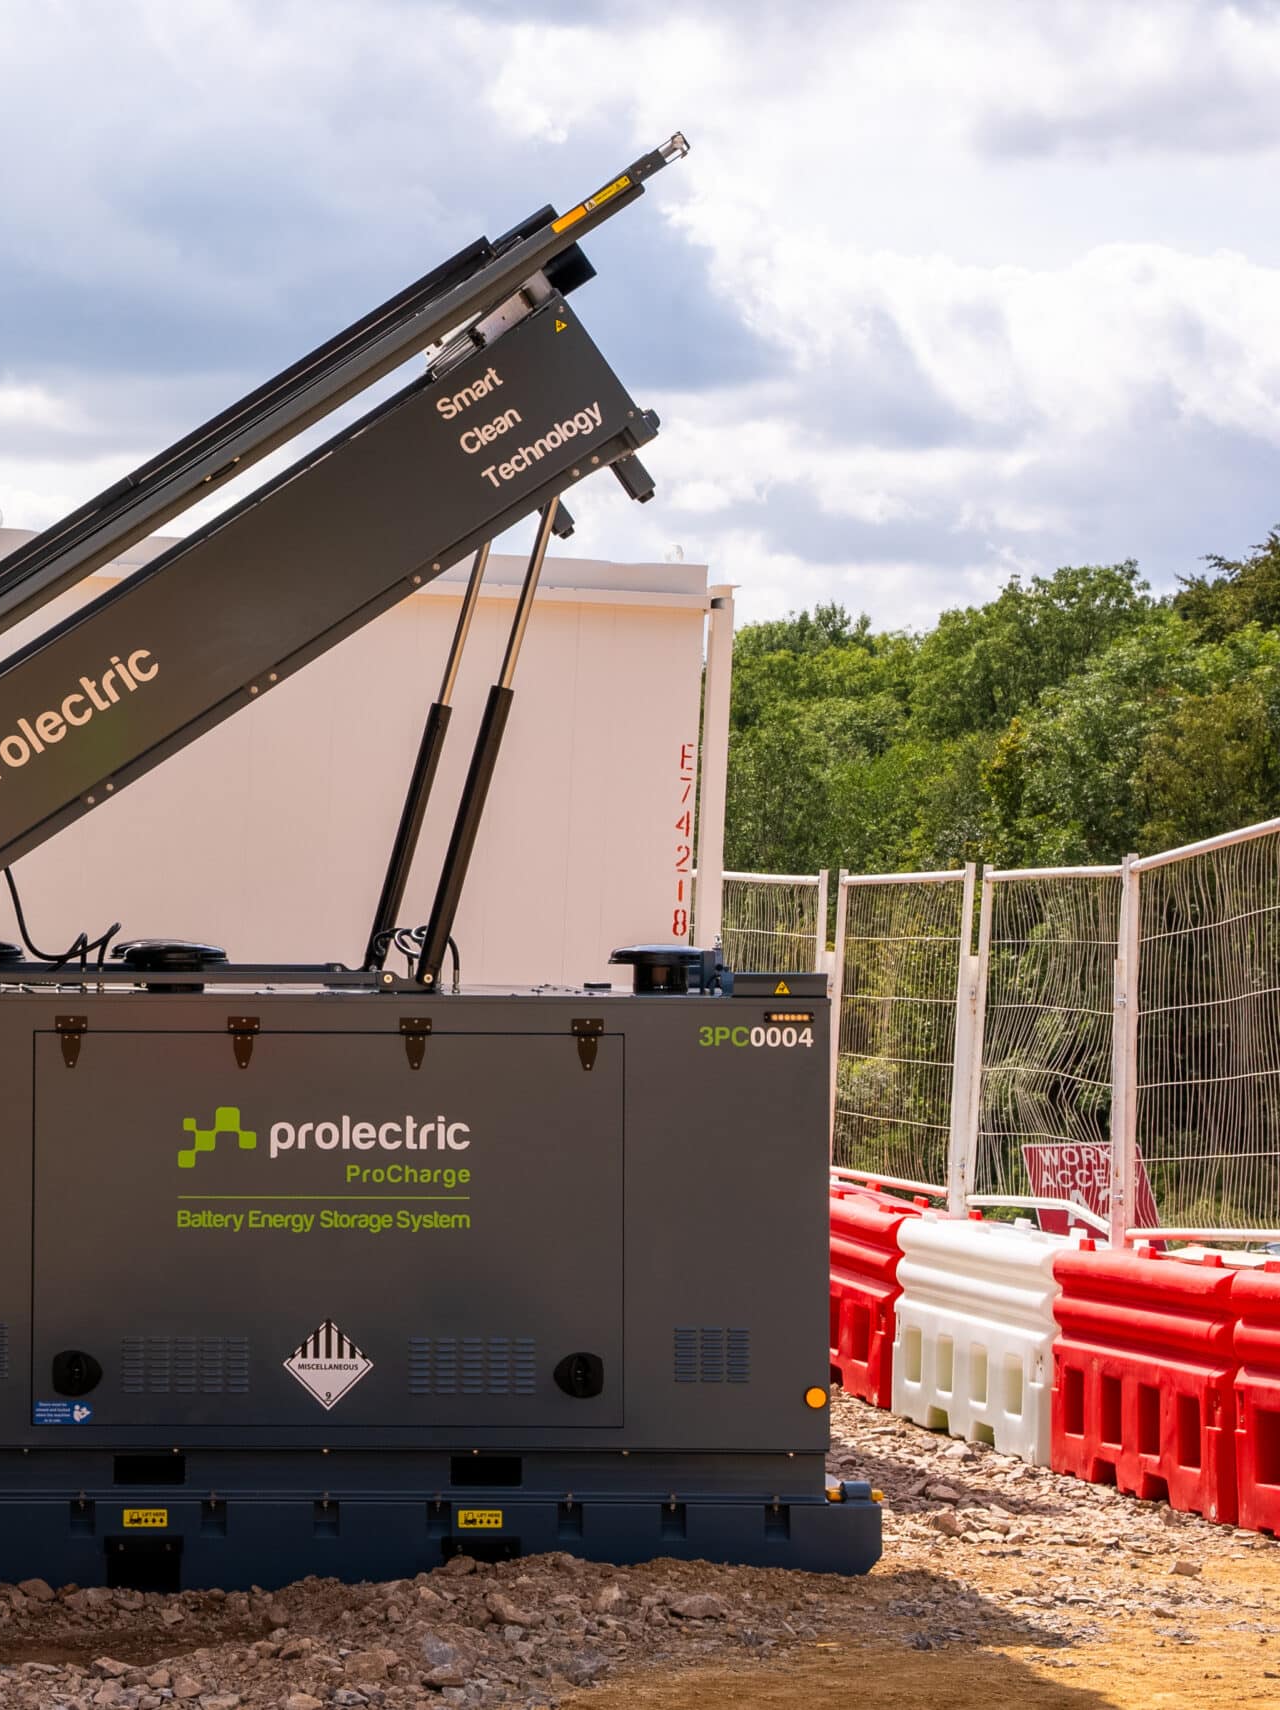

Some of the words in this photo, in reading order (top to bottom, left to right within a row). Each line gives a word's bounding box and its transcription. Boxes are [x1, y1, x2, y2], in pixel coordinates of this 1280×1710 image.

[435, 367, 504, 420] Smart
[459, 408, 523, 454] Clean
[480, 401, 603, 488] Technology
[698, 1026, 814, 1048] 3PC0004
[269, 1115, 470, 1159] prolectric
[1039, 1147, 1112, 1166] WORK
[346, 1164, 471, 1188] ProCharge
[176, 1210, 244, 1232] Battery
[248, 1210, 315, 1232] Energy
[319, 1210, 393, 1233] Storage
[396, 1210, 471, 1232] System
[297, 1363, 359, 1371] MISCELLANEOUS
[325, 1391, 332, 1400] 9
